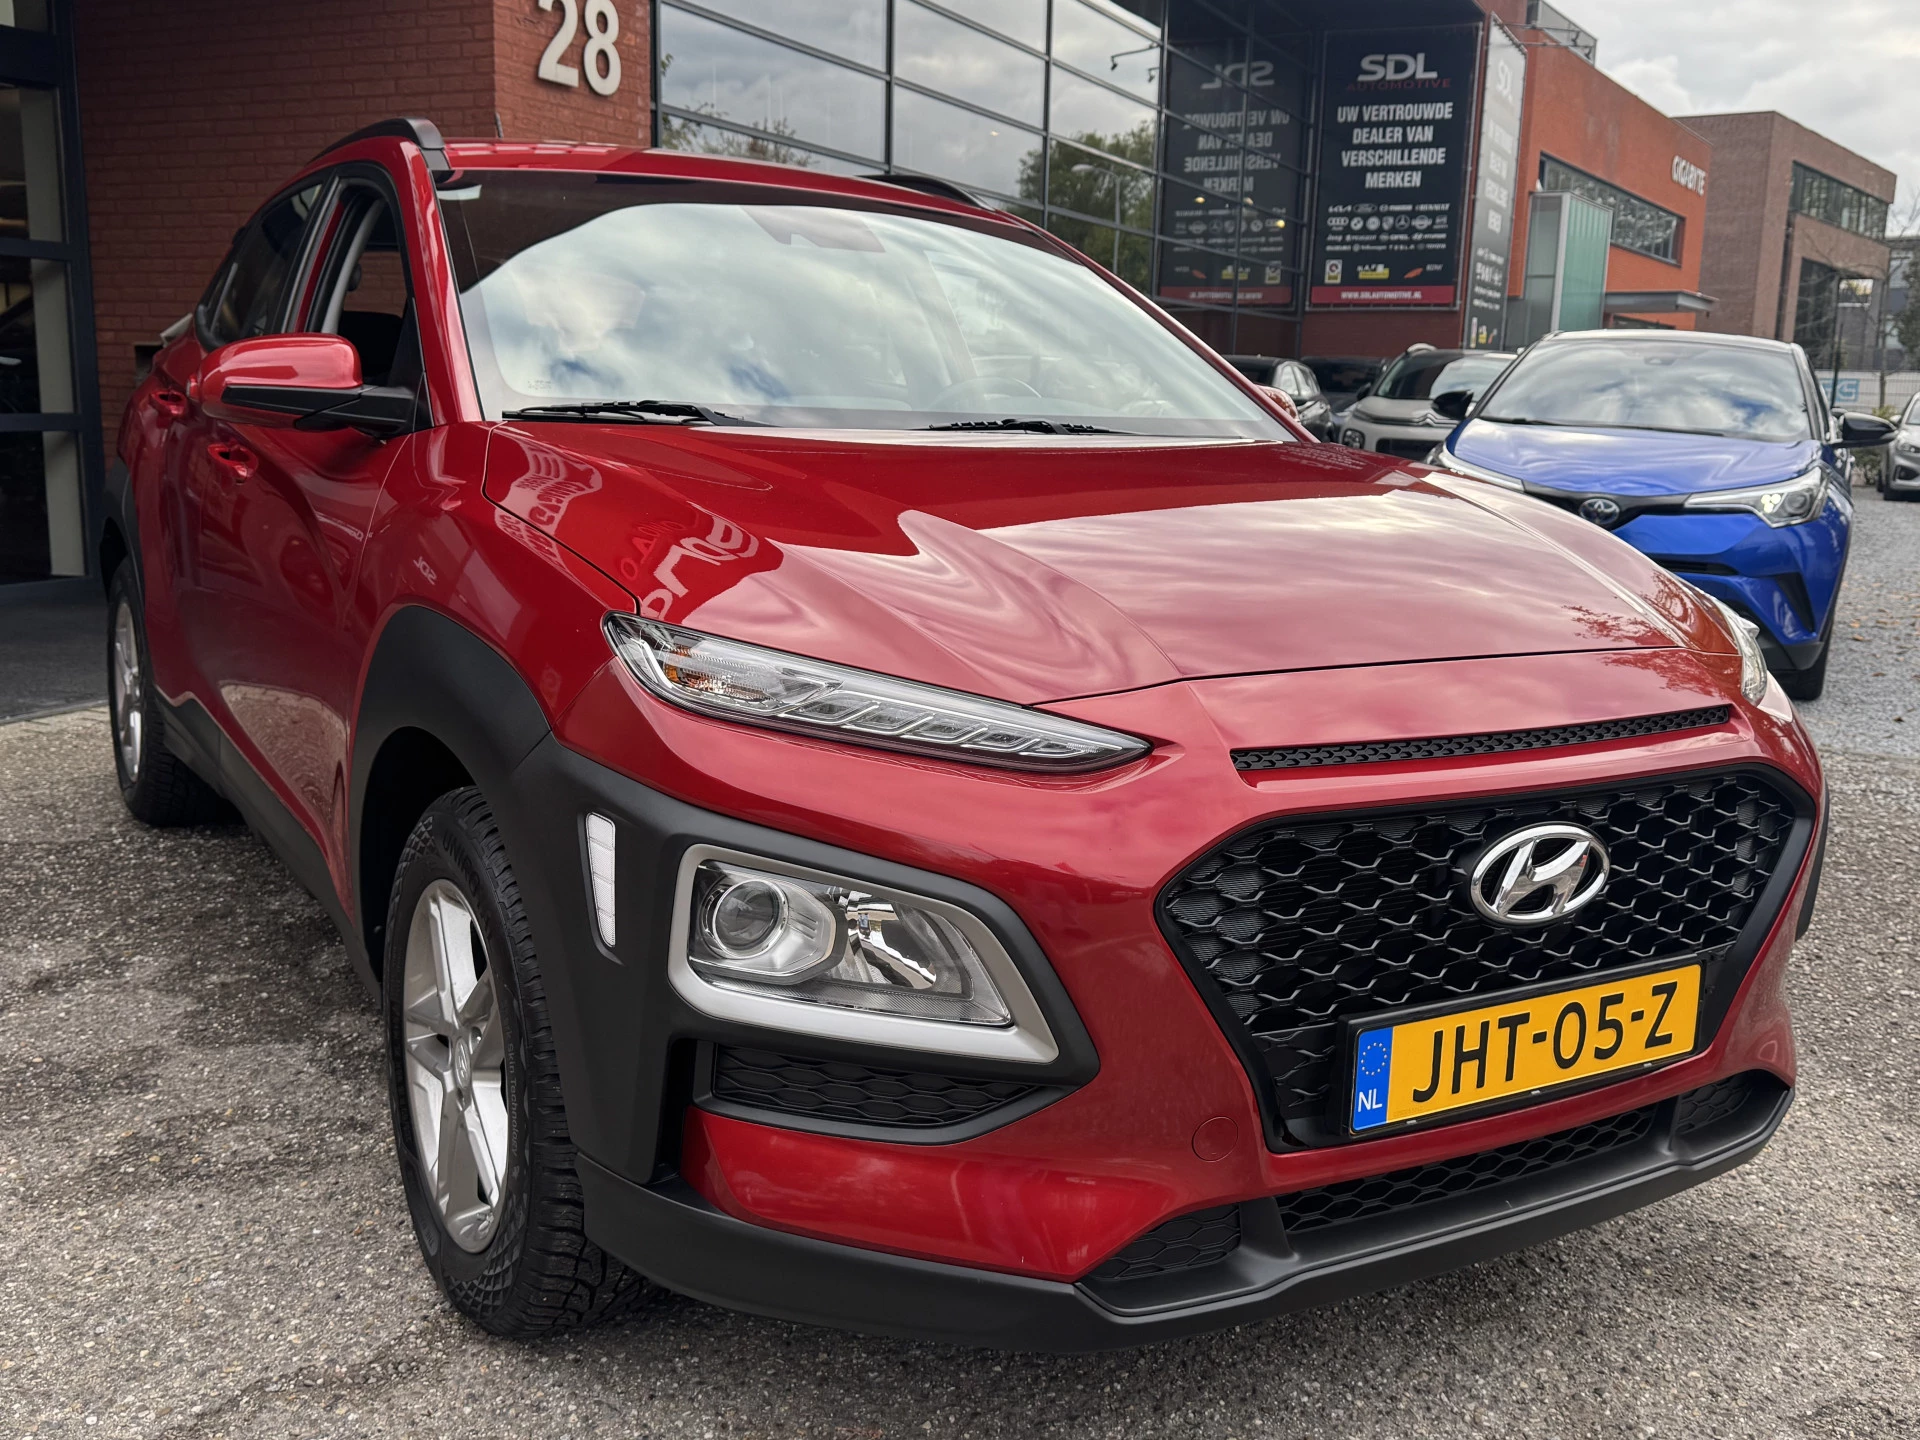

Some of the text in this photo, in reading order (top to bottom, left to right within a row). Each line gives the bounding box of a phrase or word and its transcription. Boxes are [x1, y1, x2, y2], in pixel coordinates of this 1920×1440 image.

[538, 0, 621, 96] 28
[1357, 52, 1438, 82] SDL
[1346, 77, 1451, 92] AUTOMOTIVE
[1337, 102, 1453, 123] UW VERTROUWDE
[1352, 125, 1434, 144] DEALER VAN
[1341, 147, 1446, 167] VERSCHILLENDE
[1365, 170, 1422, 189] MERKEN
[1412, 981, 1678, 1103] JHT-05-Z
[1357, 1088, 1383, 1113] NL
